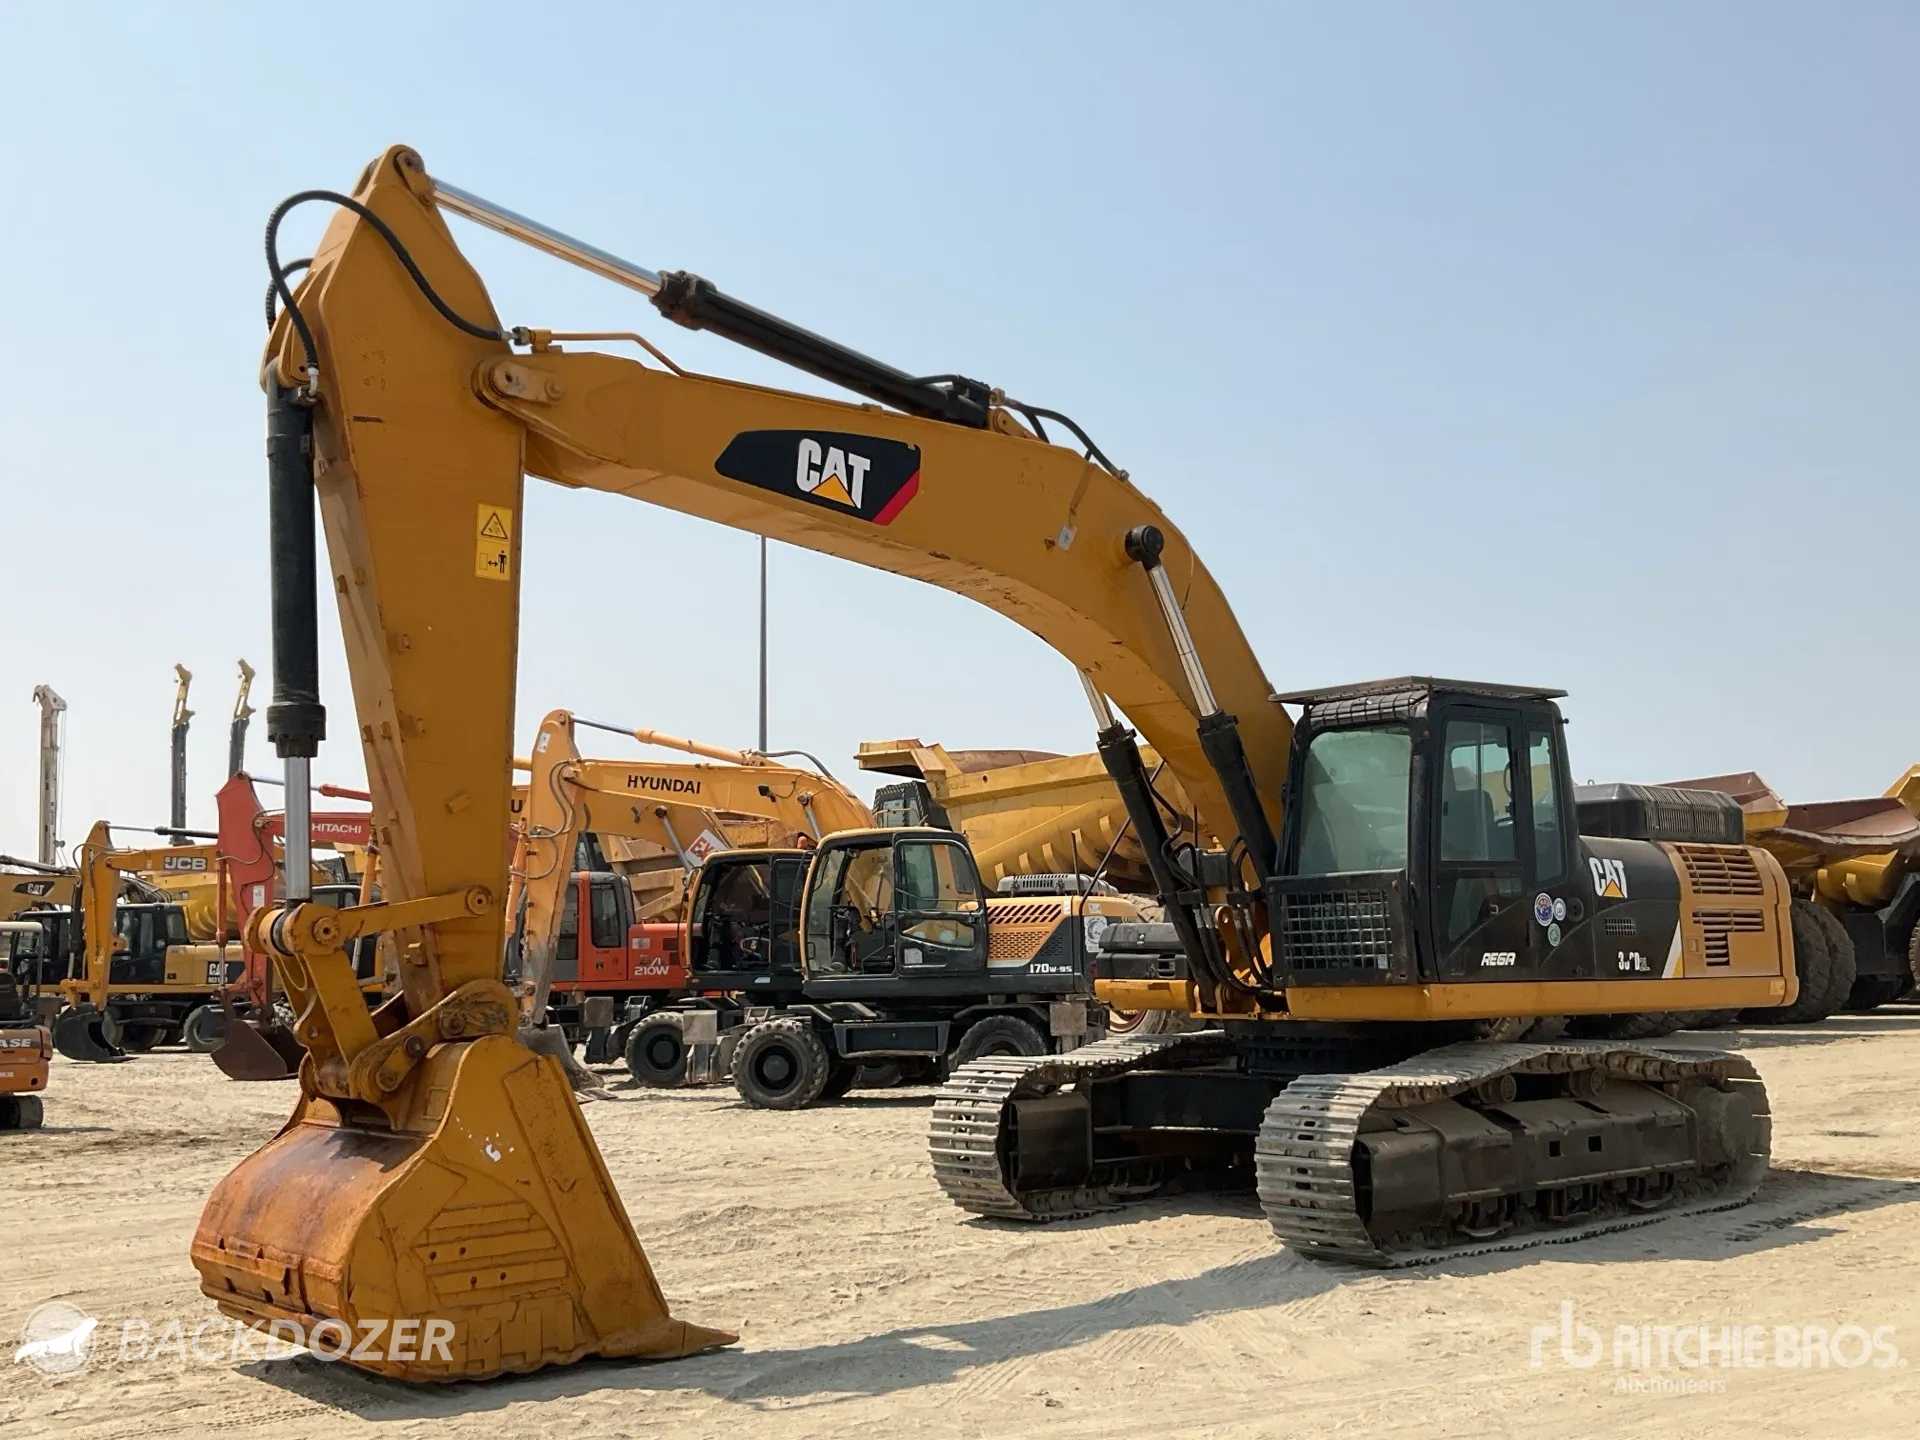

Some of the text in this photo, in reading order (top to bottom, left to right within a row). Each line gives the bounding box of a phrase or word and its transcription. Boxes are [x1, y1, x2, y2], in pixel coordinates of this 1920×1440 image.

[796, 438, 871, 510] CAT
[627, 774, 701, 794] HYUNDAI
[311, 822, 362, 834] HITACHI
[164, 856, 207, 871] JCB
[1588, 857, 1628, 899] CAT
[27, 883, 45, 896] CAT
[634, 966, 669, 976] 210W
